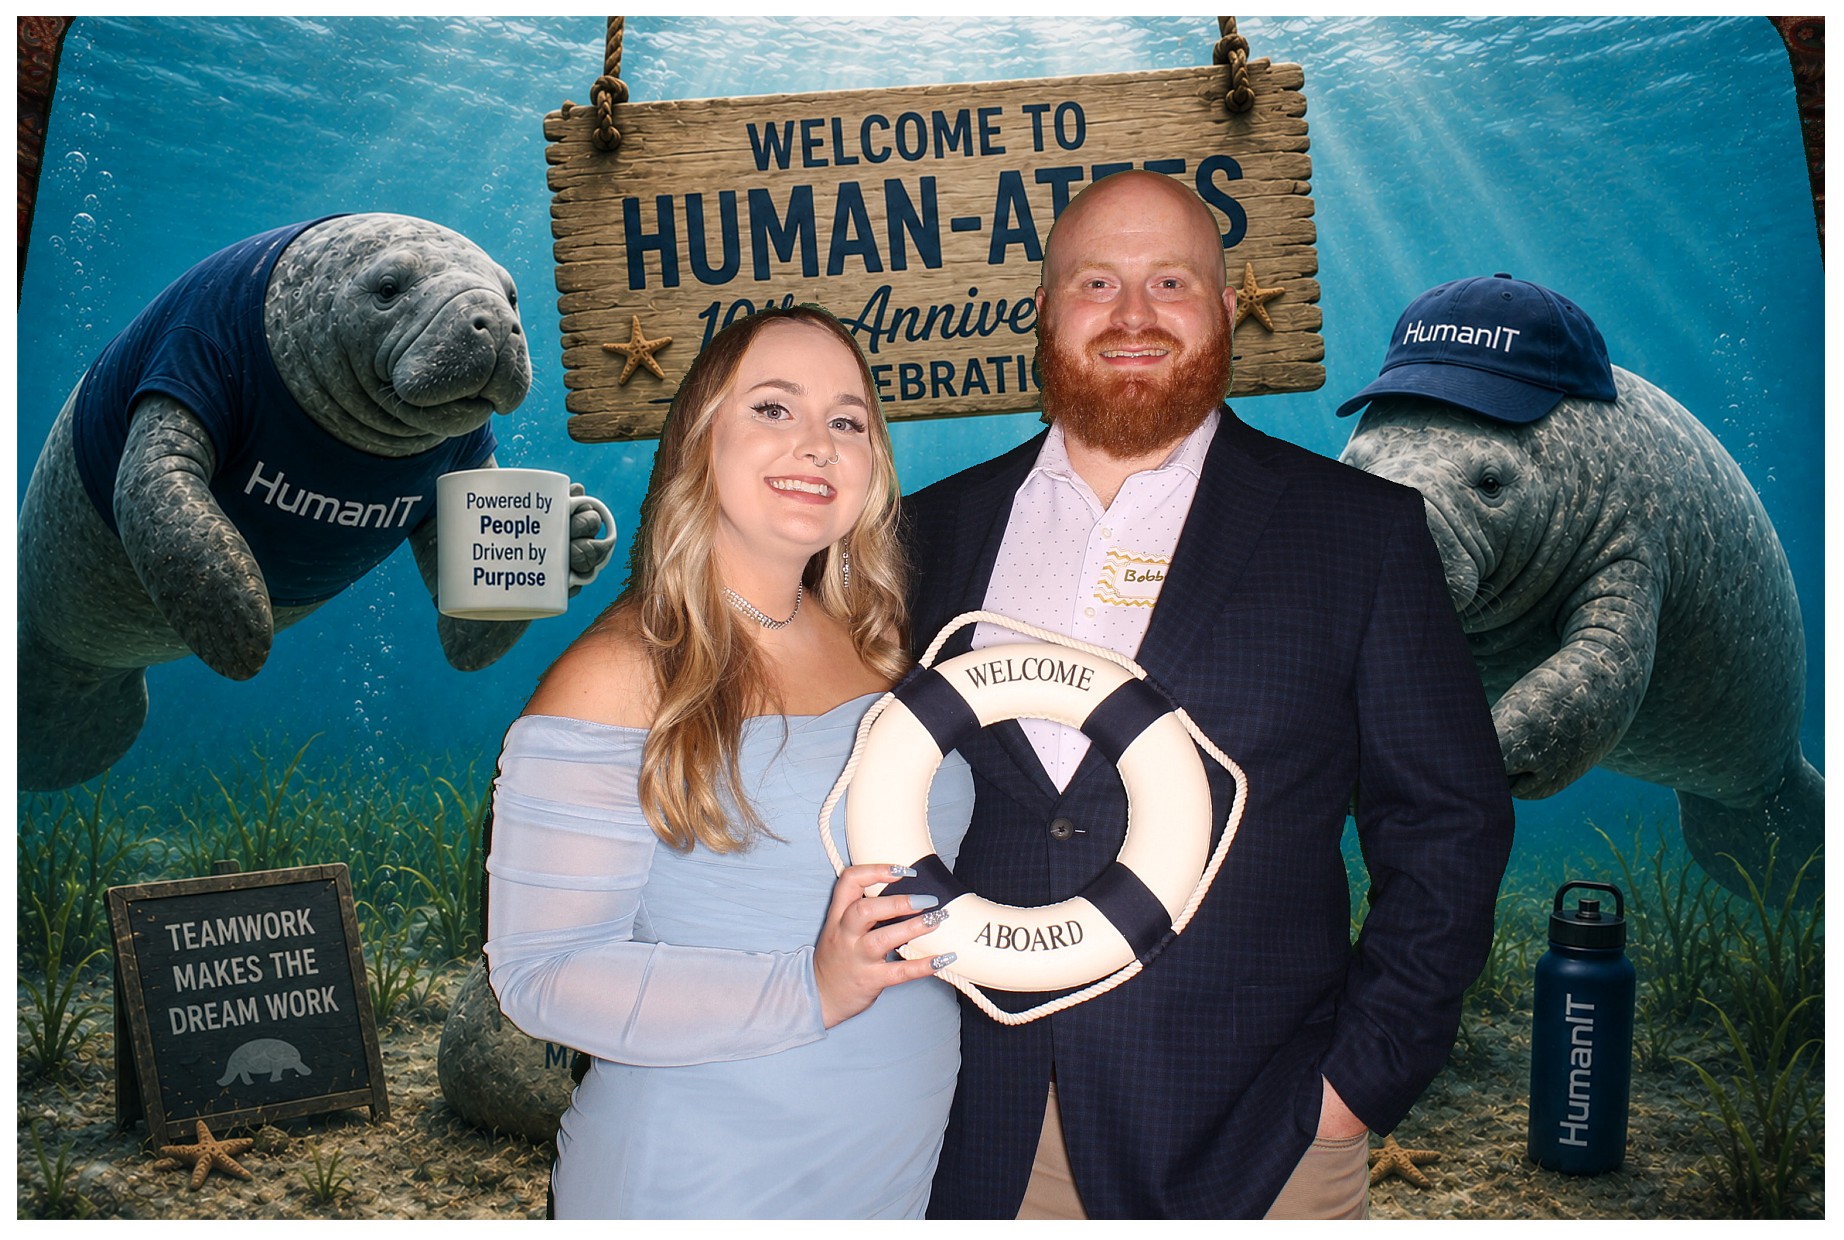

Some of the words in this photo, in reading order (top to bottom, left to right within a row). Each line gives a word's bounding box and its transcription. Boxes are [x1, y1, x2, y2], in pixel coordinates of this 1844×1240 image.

[747, 106, 1006, 172] WELCOME
[1022, 101, 1086, 152] TO
[622, 154, 1248, 291] HUMAN-ATS
[840, 284, 1038, 354] Annive
[1403, 319, 1520, 353] HumanIT
[870, 354, 1041, 403] EBRATI
[243, 460, 423, 530] HumanIT
[466, 491, 532, 510] Powered
[536, 491, 553, 514] by
[480, 514, 541, 539] People
[472, 542, 524, 561] Driven
[529, 542, 547, 566] by
[1123, 569, 1165, 582] Bobb
[473, 567, 546, 591] Purpose
[964, 657, 1095, 693] WELCOME
[164, 908, 316, 952] TEAMWORK
[974, 920, 1084, 953] ABOARD
[172, 954, 264, 993] MAKES
[269, 948, 320, 979] THE
[168, 996, 260, 1036] DREAM
[264, 985, 340, 1021] WORK
[1558, 993, 1596, 1148] HumanIT
